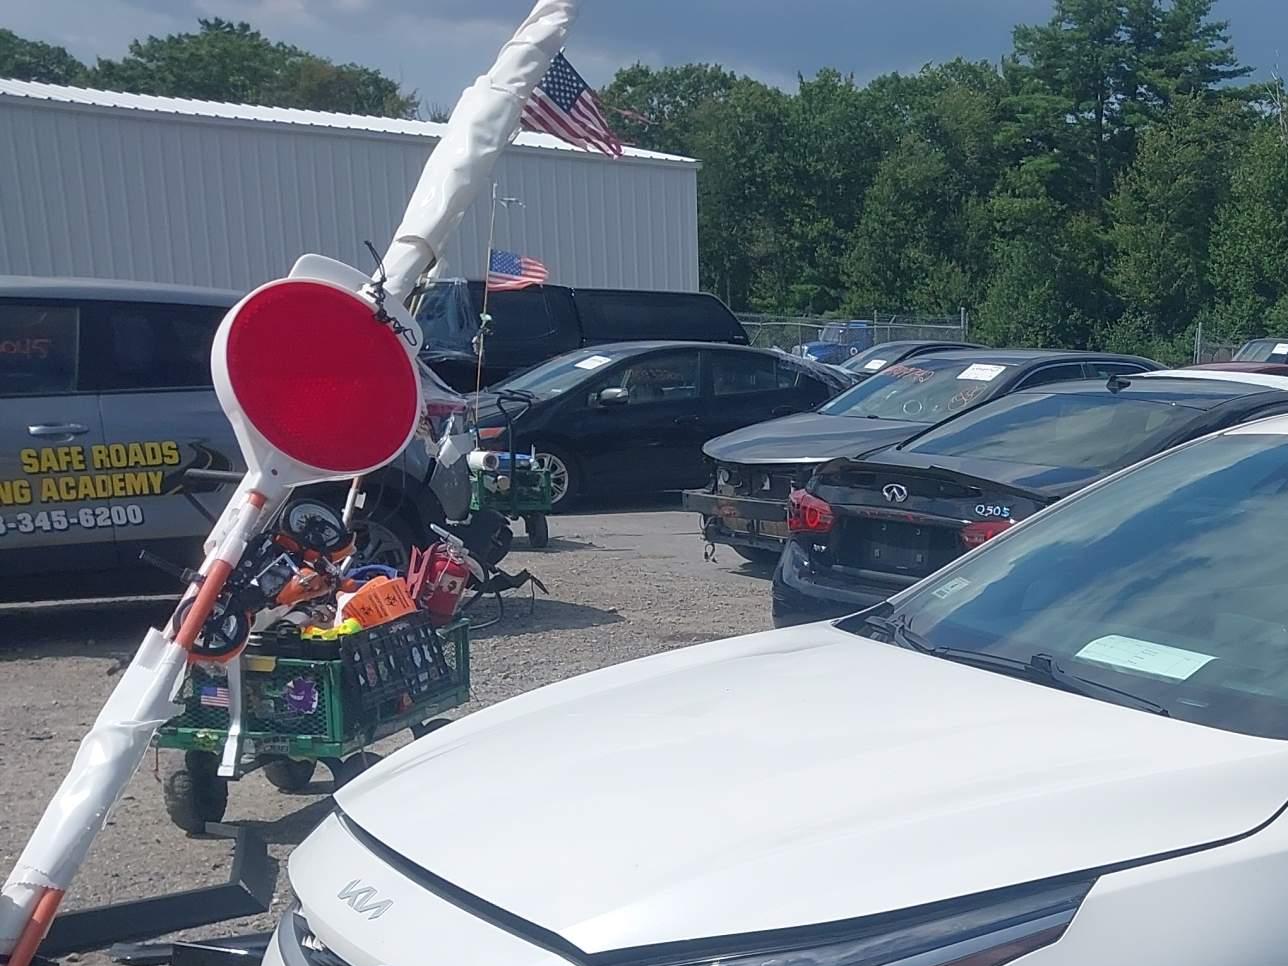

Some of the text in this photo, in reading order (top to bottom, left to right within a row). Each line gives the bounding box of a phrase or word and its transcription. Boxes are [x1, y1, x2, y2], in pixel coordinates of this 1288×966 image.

[20, 440, 181, 474] SAFE ROADS
[0, 471, 165, 506] NG ACADEMY
